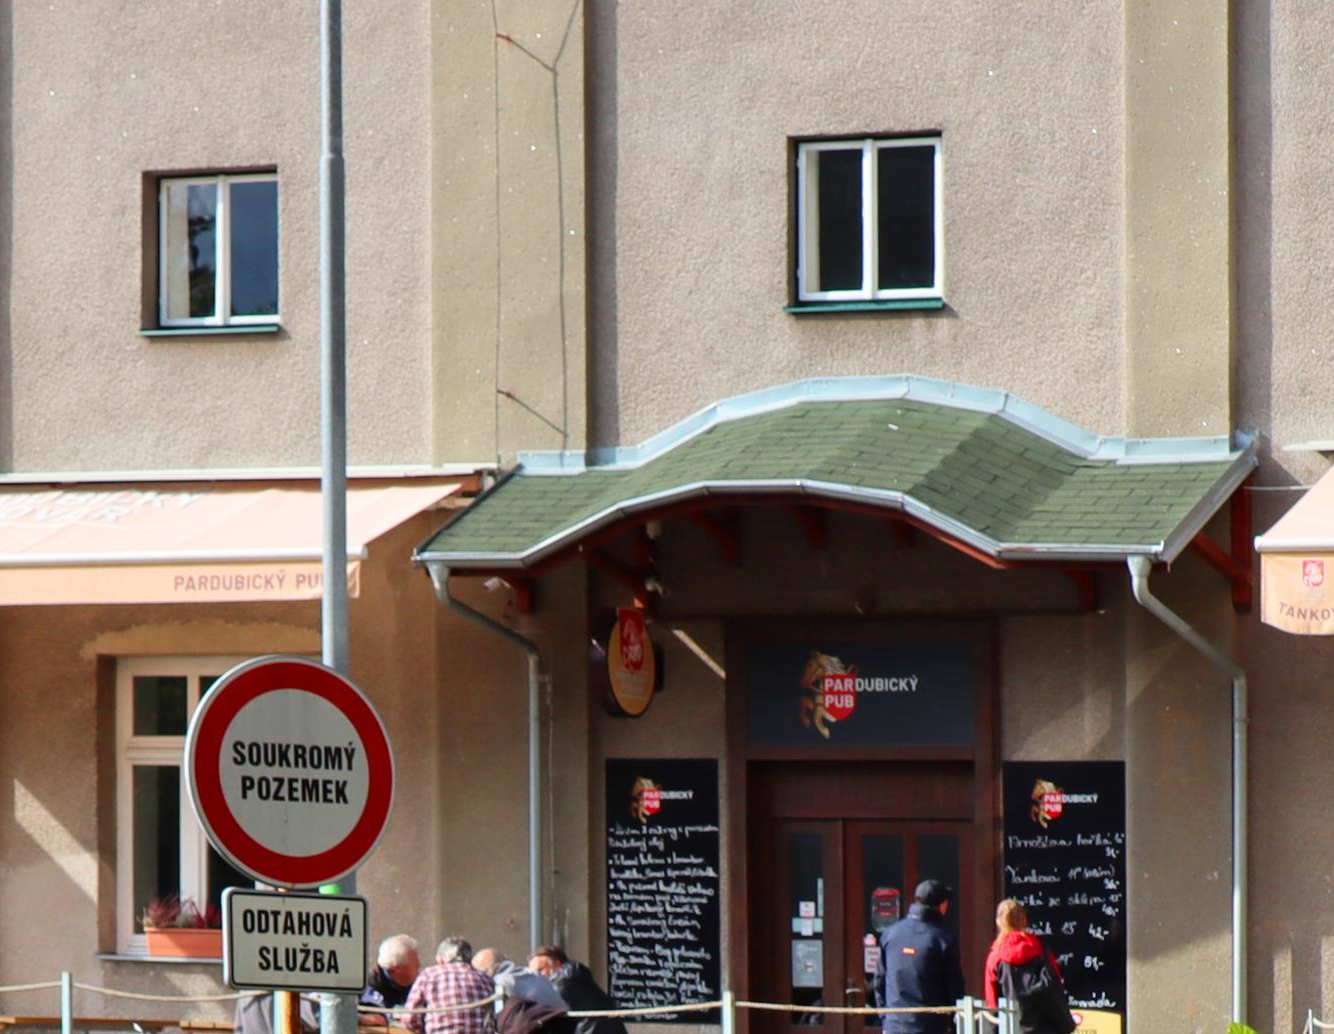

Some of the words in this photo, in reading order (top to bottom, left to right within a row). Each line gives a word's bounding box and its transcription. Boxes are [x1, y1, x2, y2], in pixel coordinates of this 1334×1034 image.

[173, 568, 286, 592] PARDUBICKÝ
[295, 573, 324, 590] PU
[824, 674, 919, 693] PARDUBICKÝ
[824, 694, 855, 709] PUB
[231, 740, 357, 772] SOUKROMÝ
[241, 775, 349, 805] POZEMEK
[242, 907, 353, 939] ODTAHOVÁ
[258, 943, 340, 975] SLUŽBA
